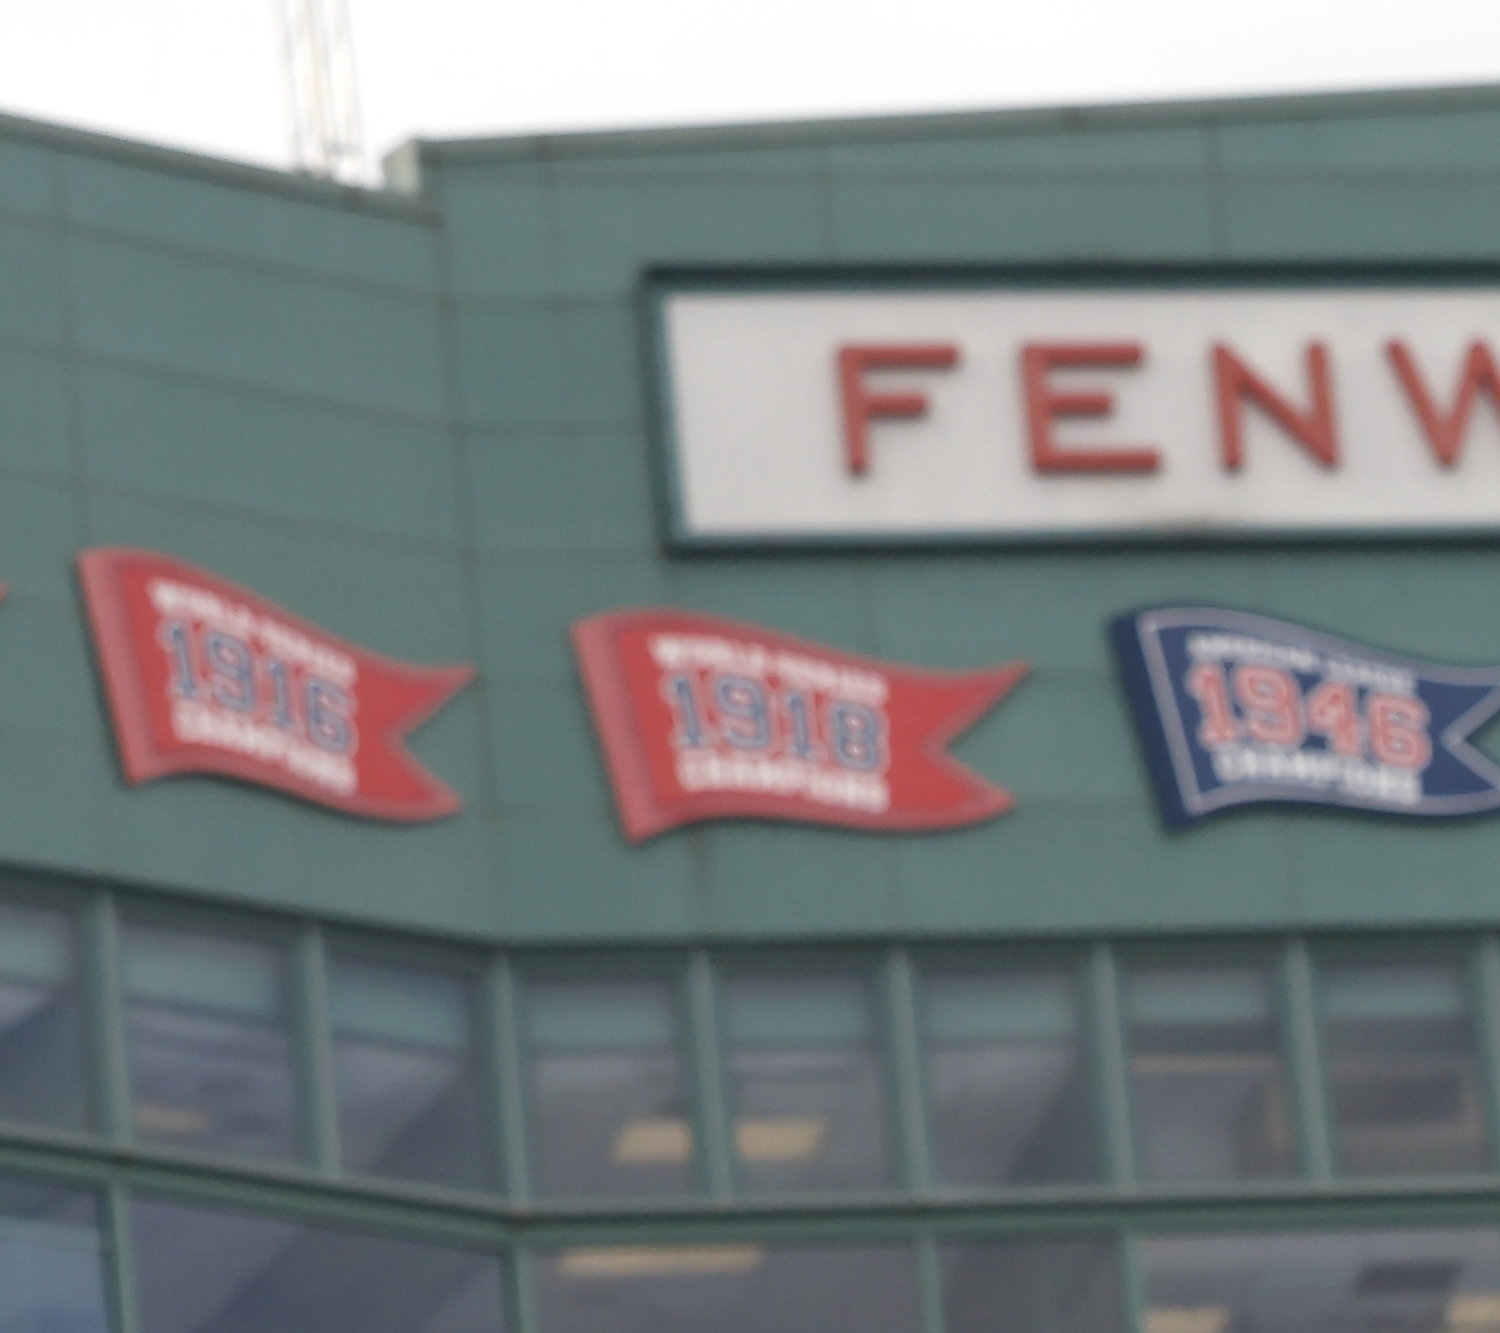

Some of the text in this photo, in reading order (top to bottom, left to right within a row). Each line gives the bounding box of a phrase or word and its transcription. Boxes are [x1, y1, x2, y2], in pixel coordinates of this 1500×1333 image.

[160, 616, 356, 755] 1916
[666, 672, 887, 772] 1918
[1187, 661, 1432, 771] 1946
